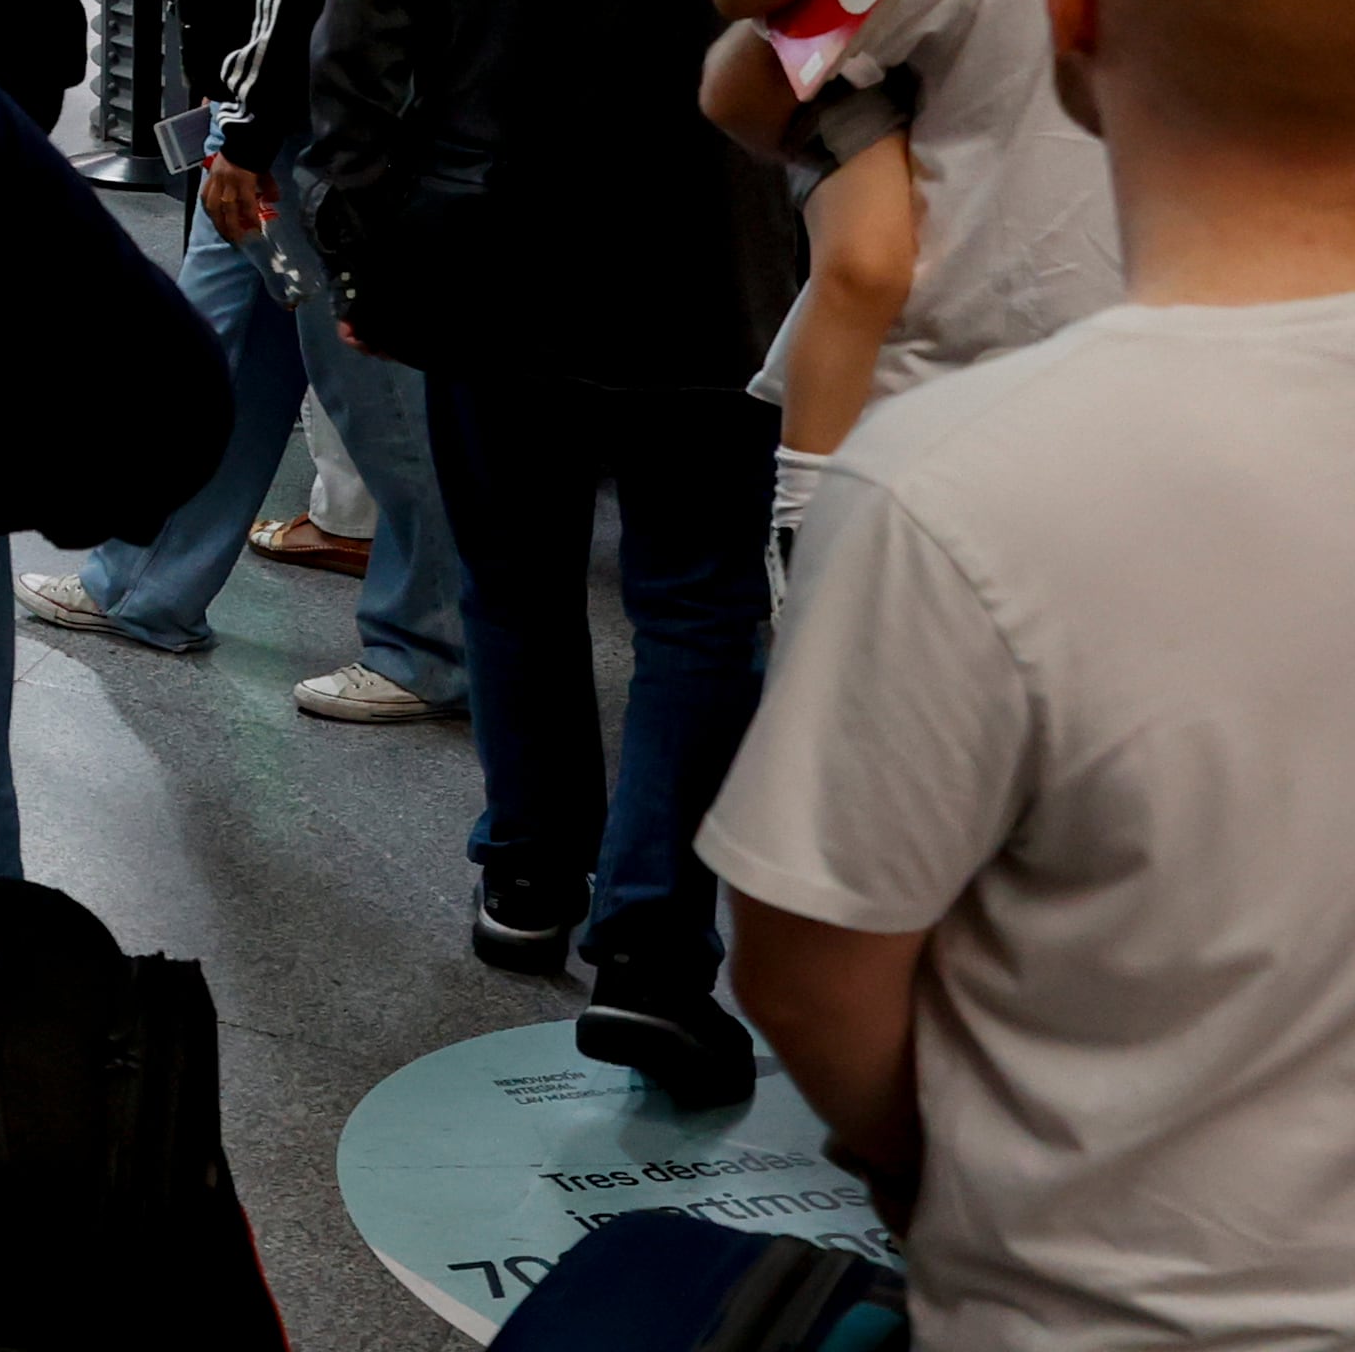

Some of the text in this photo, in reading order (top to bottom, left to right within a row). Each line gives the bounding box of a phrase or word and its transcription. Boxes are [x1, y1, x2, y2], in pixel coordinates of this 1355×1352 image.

[493, 1068, 586, 1087] RENOVACIÓN
[504, 1082, 576, 1096] INTEGRAL
[539, 1149, 817, 1193] Tres décadas
[565, 1184, 867, 1231] inrtimos
